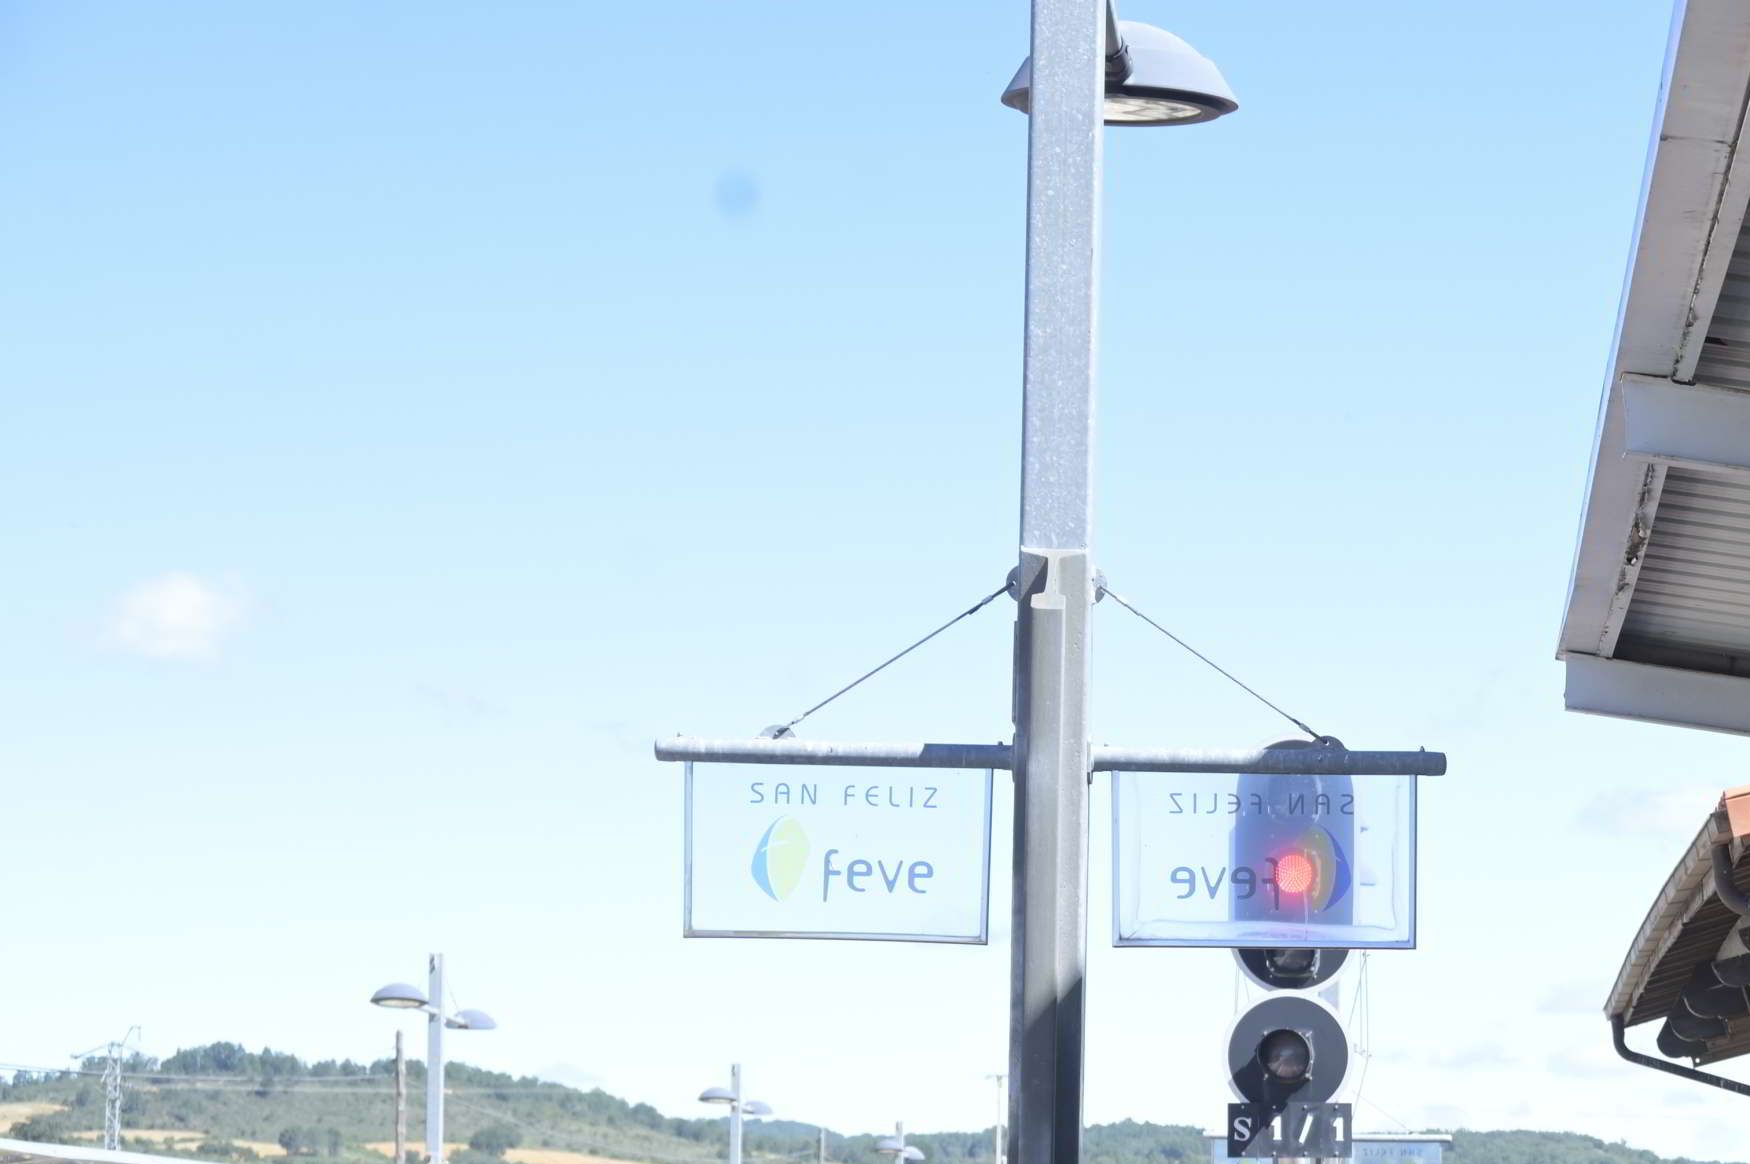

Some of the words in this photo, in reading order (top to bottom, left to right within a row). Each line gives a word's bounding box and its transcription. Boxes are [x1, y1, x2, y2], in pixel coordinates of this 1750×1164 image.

[749, 782, 818, 805] SAN
[843, 785, 939, 809] FELIZ
[822, 848, 935, 903] feve
